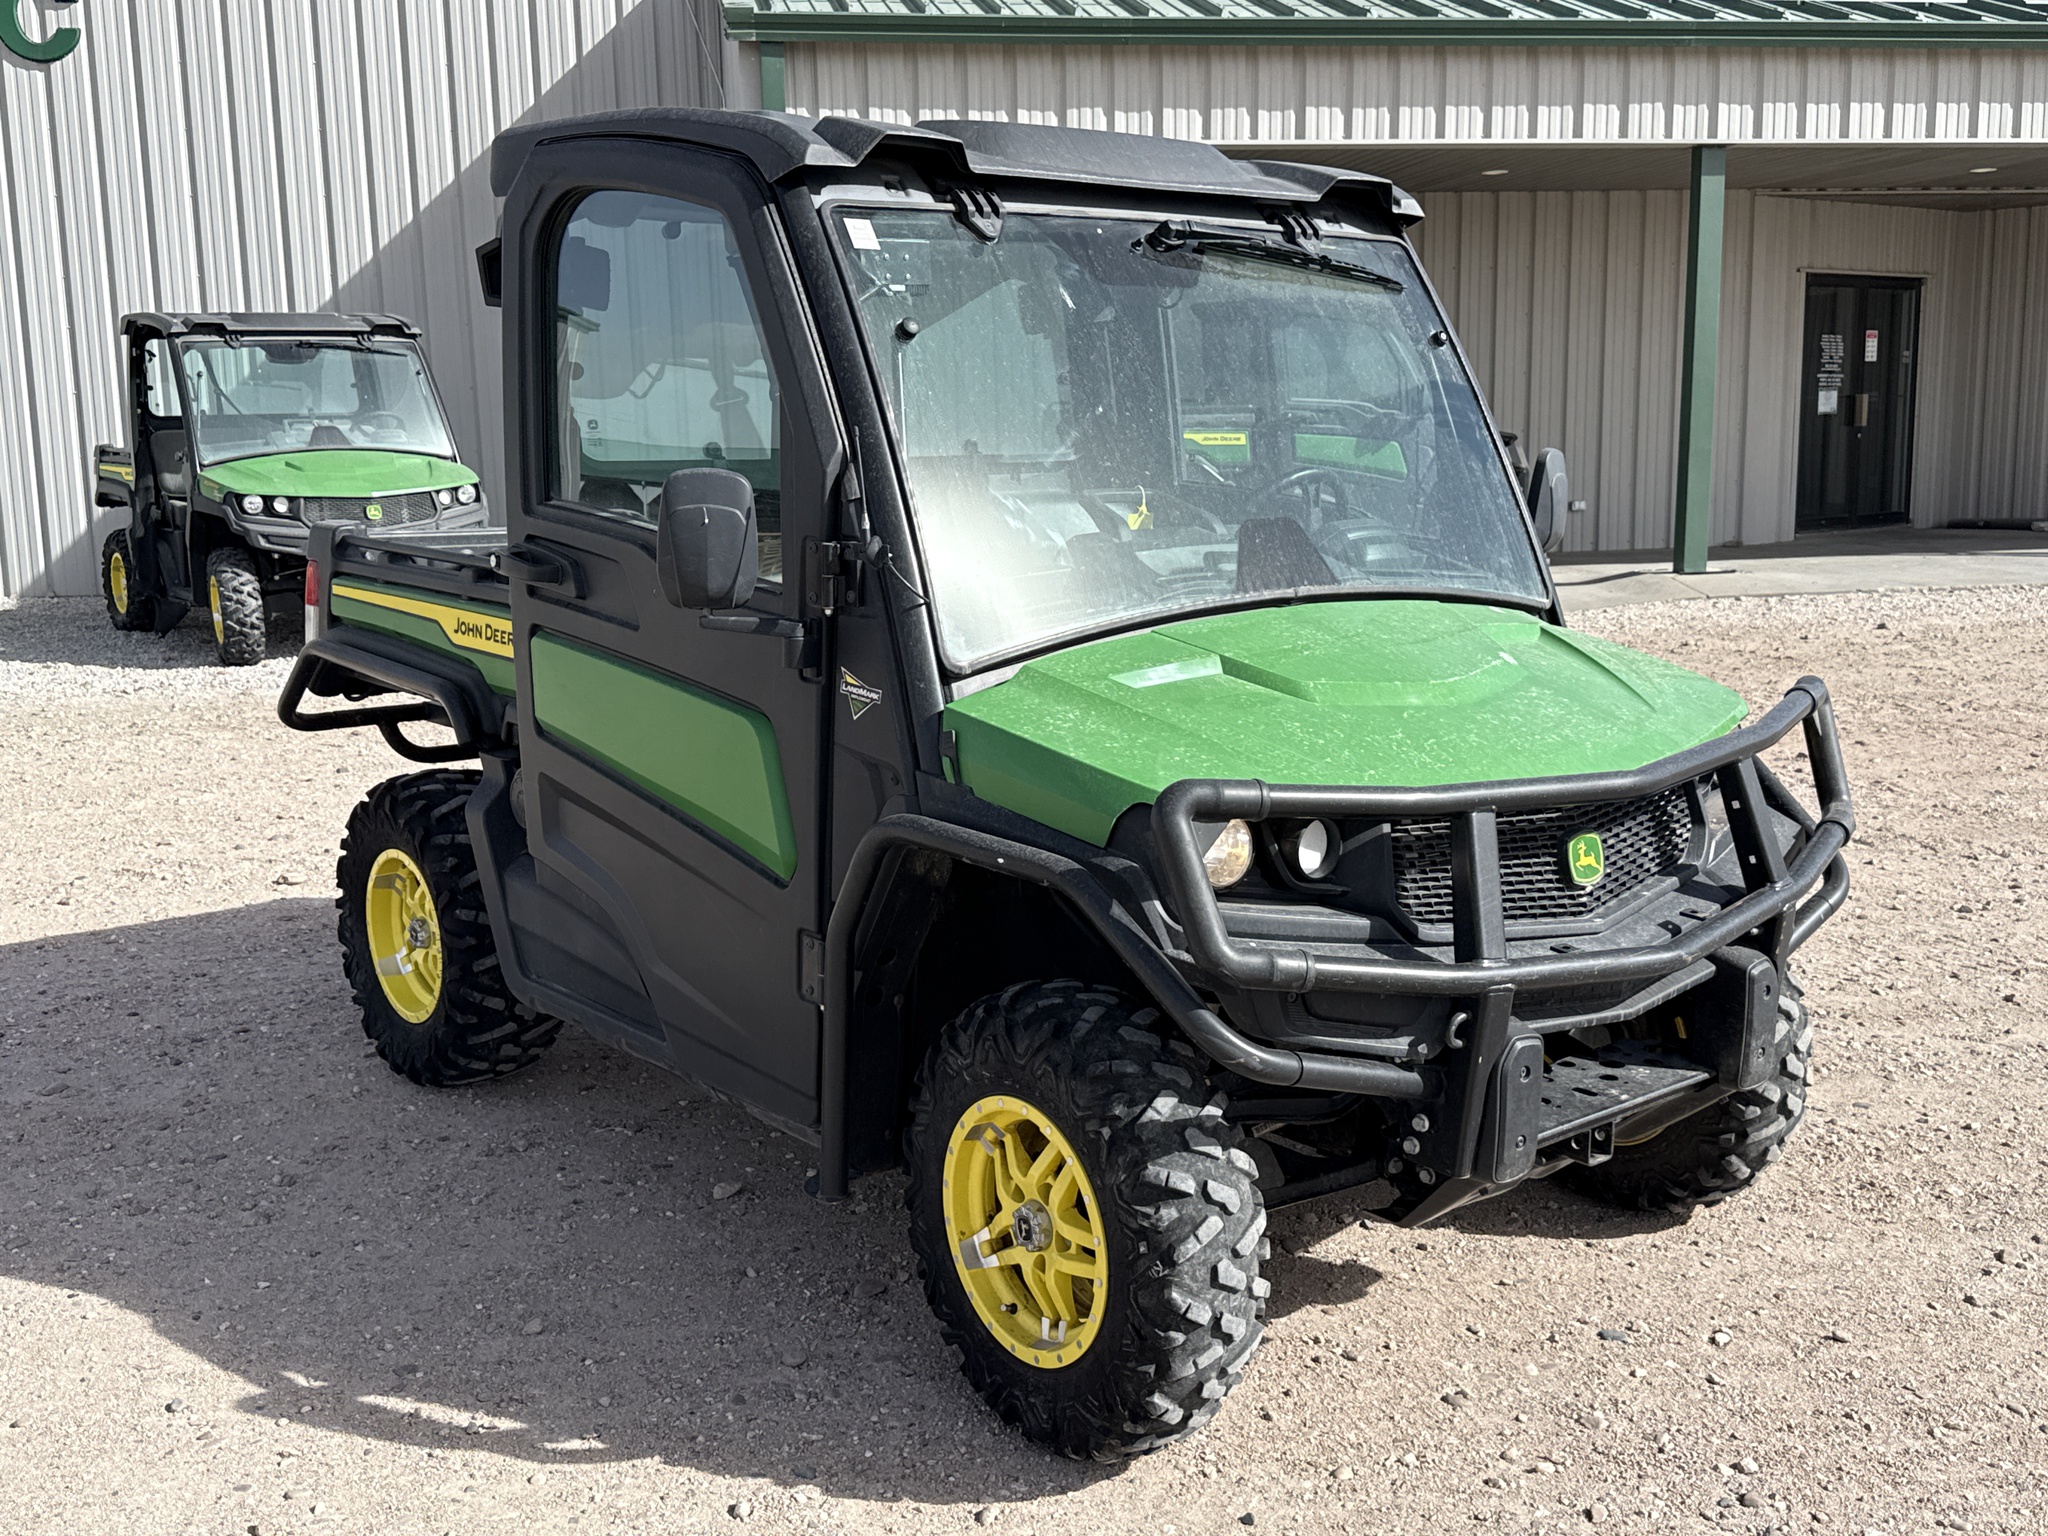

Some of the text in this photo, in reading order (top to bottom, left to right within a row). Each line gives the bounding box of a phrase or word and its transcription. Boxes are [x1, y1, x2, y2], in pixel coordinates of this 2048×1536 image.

[453, 617, 514, 646] JOHN DEER
[842, 682, 880, 700] LANDMARK
